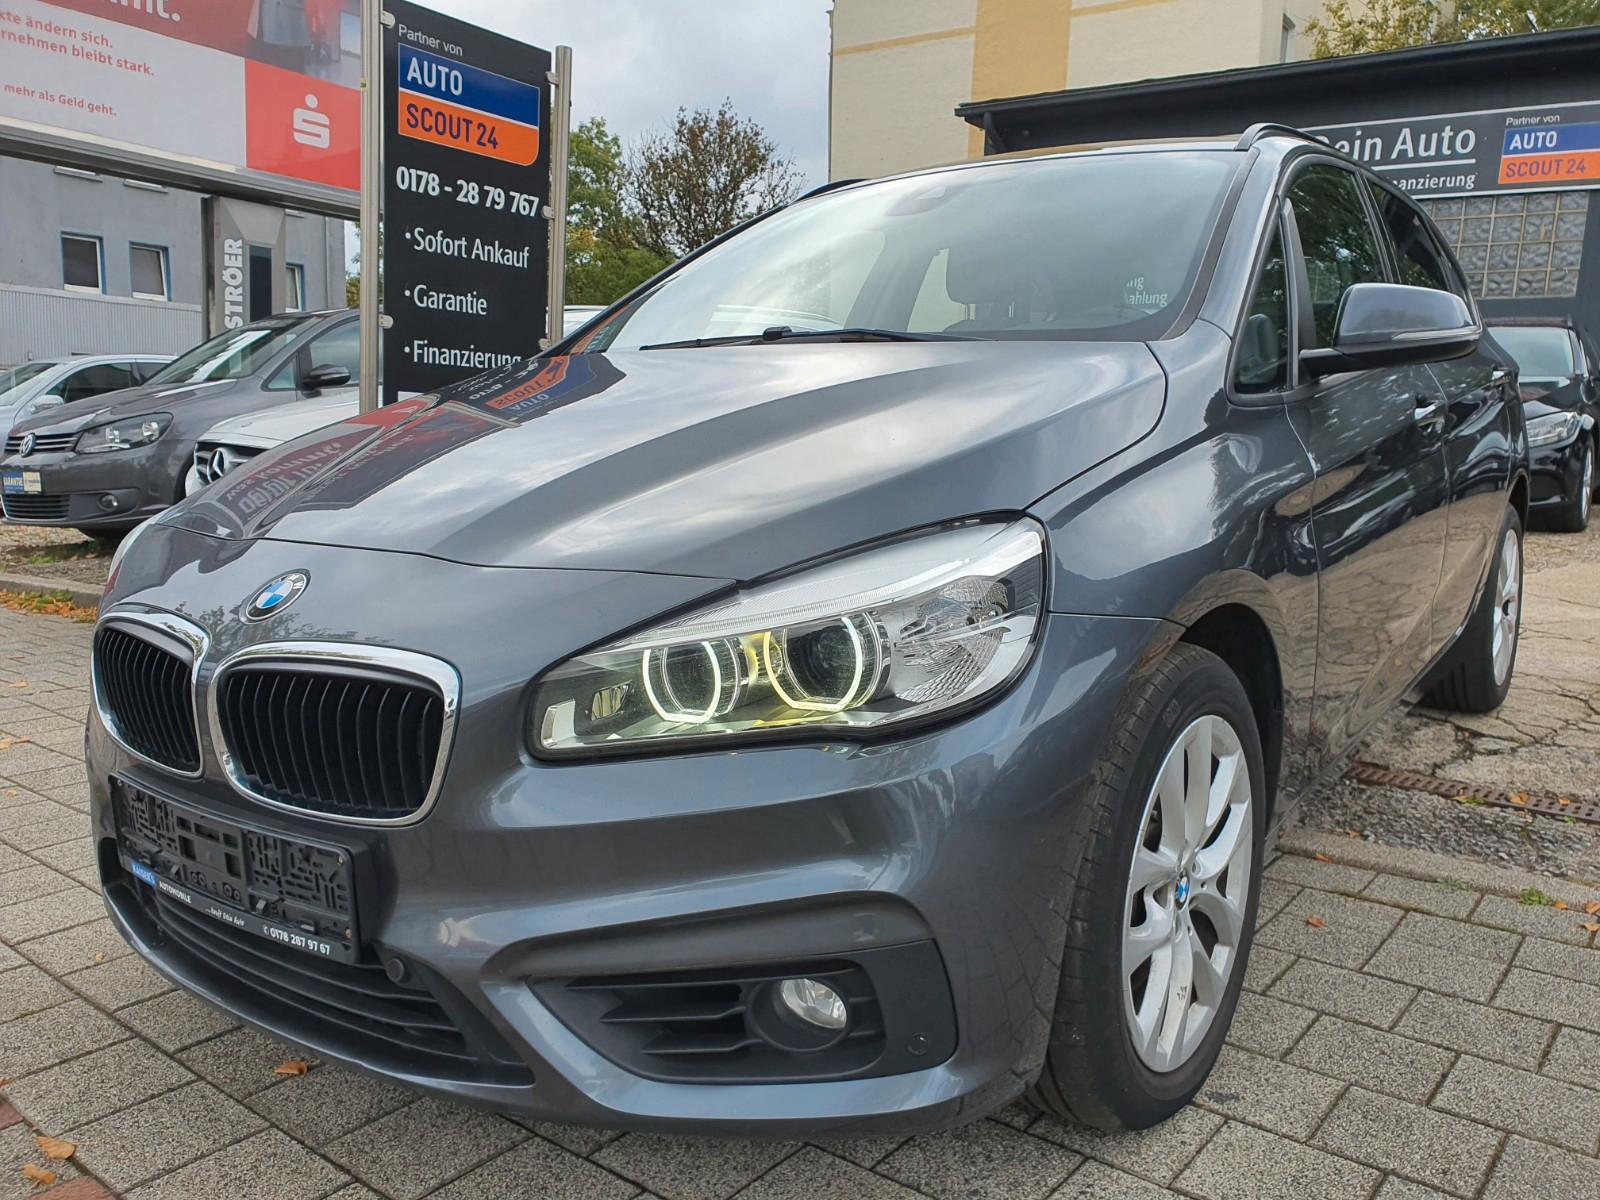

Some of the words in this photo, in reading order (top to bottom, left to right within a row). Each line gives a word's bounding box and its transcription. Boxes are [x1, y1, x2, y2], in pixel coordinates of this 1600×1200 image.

[25, 15, 77, 39] ändern
[80, 31, 113, 49] sich.
[398, 23, 440, 50] Partner
[443, 41, 463, 57] von
[71, 45, 113, 66] bleibt
[116, 58, 155, 76] stark.
[406, 56, 463, 97] AUTO
[4, 84, 36, 98] mehr
[38, 90, 55, 103] als
[58, 95, 84, 108] Geld
[87, 103, 118, 116] geht.
[1505, 115, 1541, 127] Partner
[1543, 113, 1560, 123] von
[1390, 125, 1476, 160] Auto
[1509, 130, 1558, 151] AUTO
[395, 165, 440, 197] 0178
[456, 179, 480, 205] 28
[484, 185, 505, 210] 79
[509, 191, 540, 218] 767
[1392, 172, 1476, 191] anzierung
[413, 226, 467, 259] Sofort
[471, 238, 530, 269] Ankauf
[222, 237, 244, 330] STRÖER
[413, 284, 488, 316] Garantie
[269, 926, 290, 943] 0178
[307, 939, 319, 952] 97
[320, 943, 331, 956] 67
